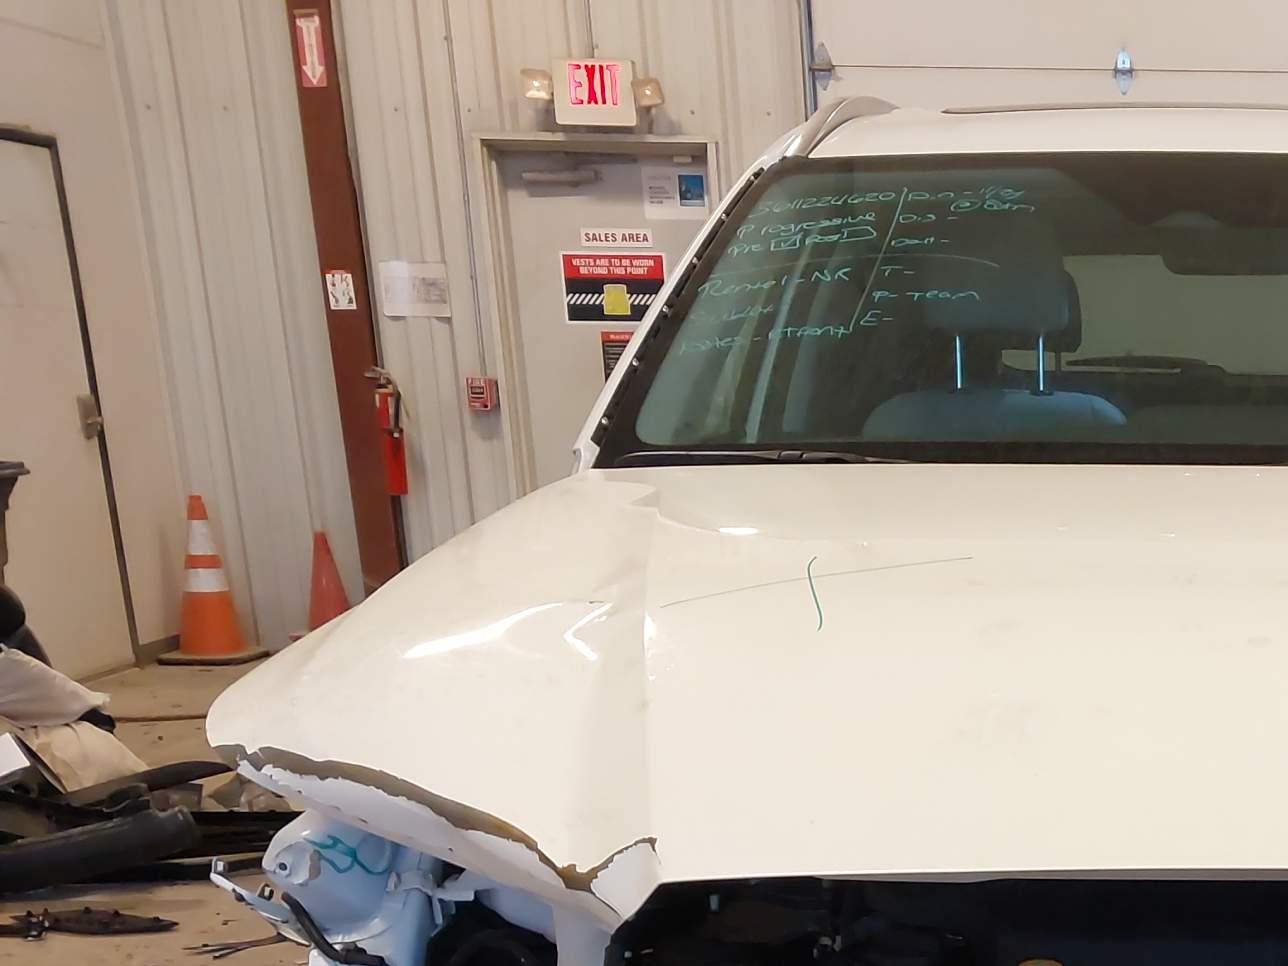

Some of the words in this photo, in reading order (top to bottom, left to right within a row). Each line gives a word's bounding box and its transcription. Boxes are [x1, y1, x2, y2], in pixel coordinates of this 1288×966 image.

[567, 63, 619, 106] EXIT
[584, 232, 617, 243] SALES
[621, 232, 649, 243] AREA
[571, 258, 594, 266] VESTS
[596, 258, 609, 266] ARE
[611, 258, 620, 267] TO
[632, 258, 654, 267] WORN
[579, 266, 608, 274] BEYOND
[610, 266, 625, 275] THIS
[627, 266, 648, 275] POINT
